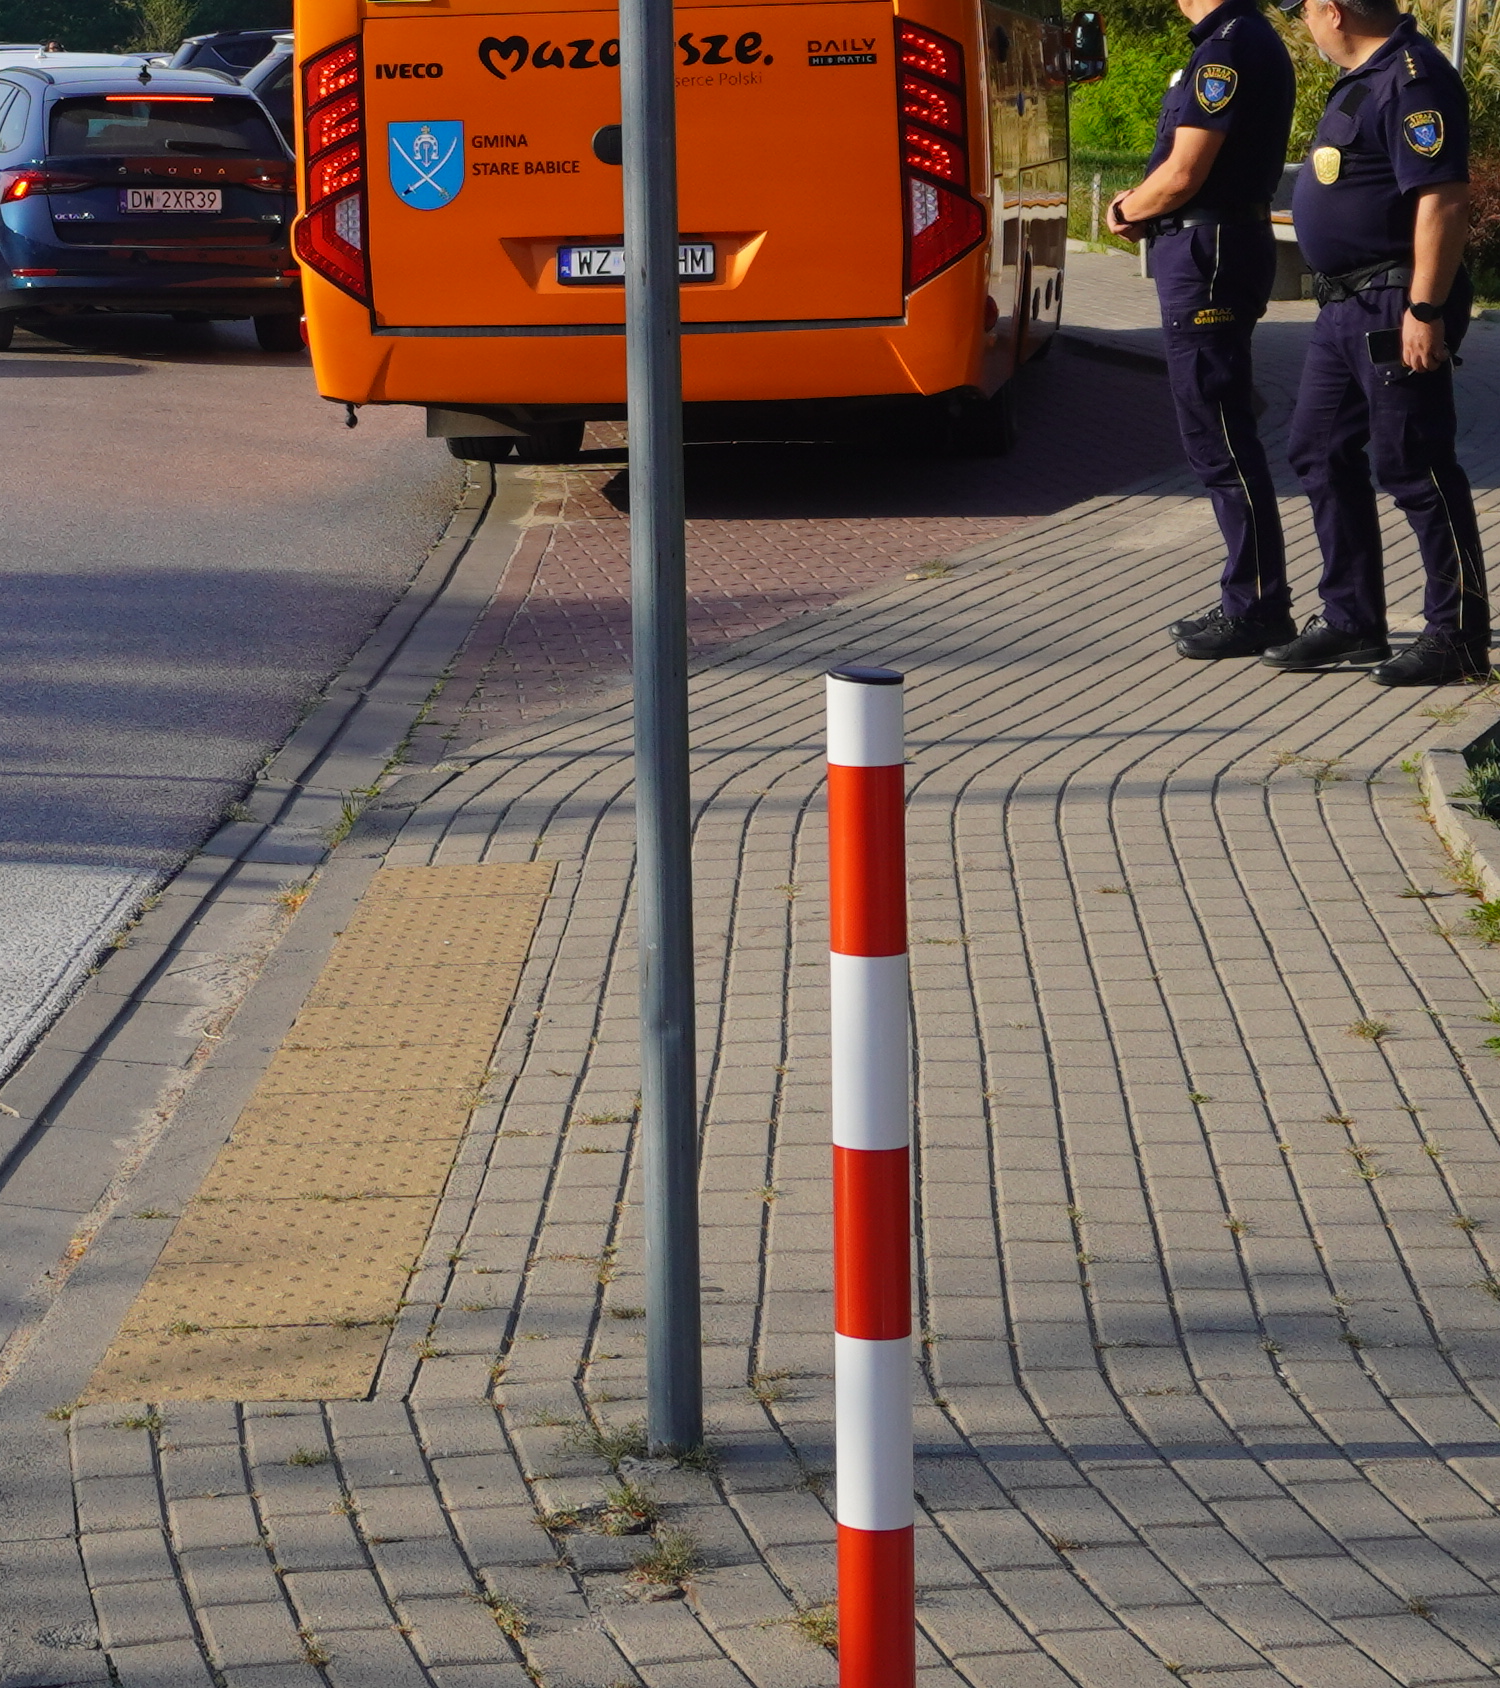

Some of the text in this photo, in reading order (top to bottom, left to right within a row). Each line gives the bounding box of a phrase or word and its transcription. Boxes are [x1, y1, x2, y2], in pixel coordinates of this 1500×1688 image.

[807, 38, 876, 53] DAILY
[375, 63, 443, 79] IVECO
[719, 71, 763, 86] Polski
[472, 134, 528, 148] GMINA
[472, 160, 580, 176] STARE BABICE
[131, 191, 217, 208] DW 2XR39
[577, 250, 611, 275] WZ
